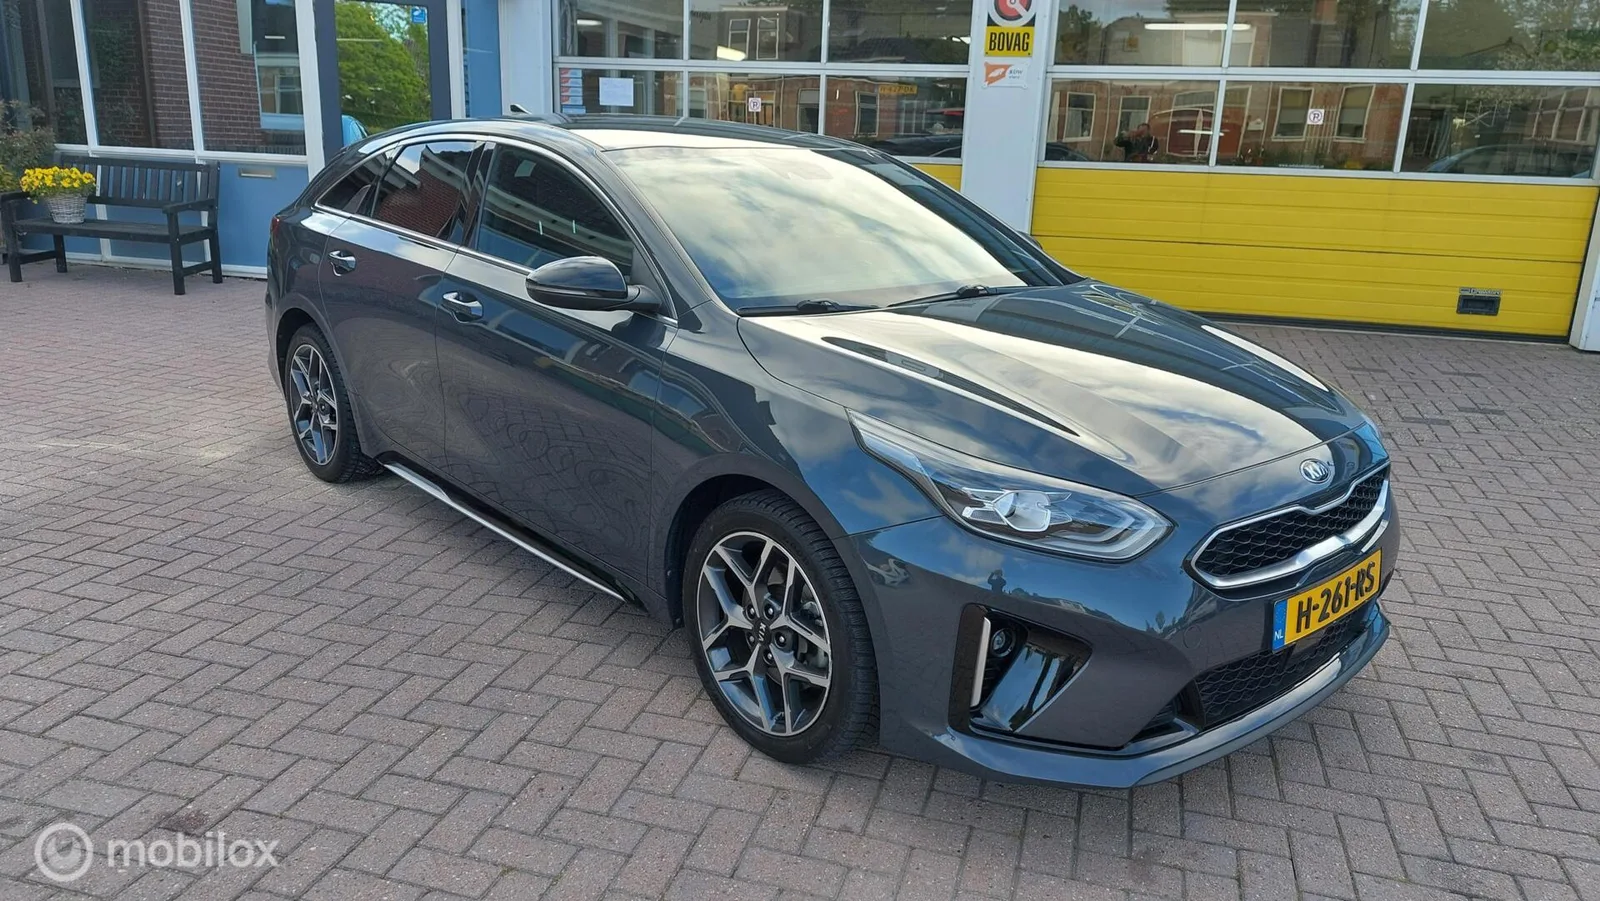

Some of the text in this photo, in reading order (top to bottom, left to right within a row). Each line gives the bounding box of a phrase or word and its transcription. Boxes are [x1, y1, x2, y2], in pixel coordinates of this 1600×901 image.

[989, 31, 1030, 52] BOVAG
[1296, 562, 1375, 633] H-261-RS
[759, 622, 767, 642] KIA
[1274, 629, 1284, 641] NL
